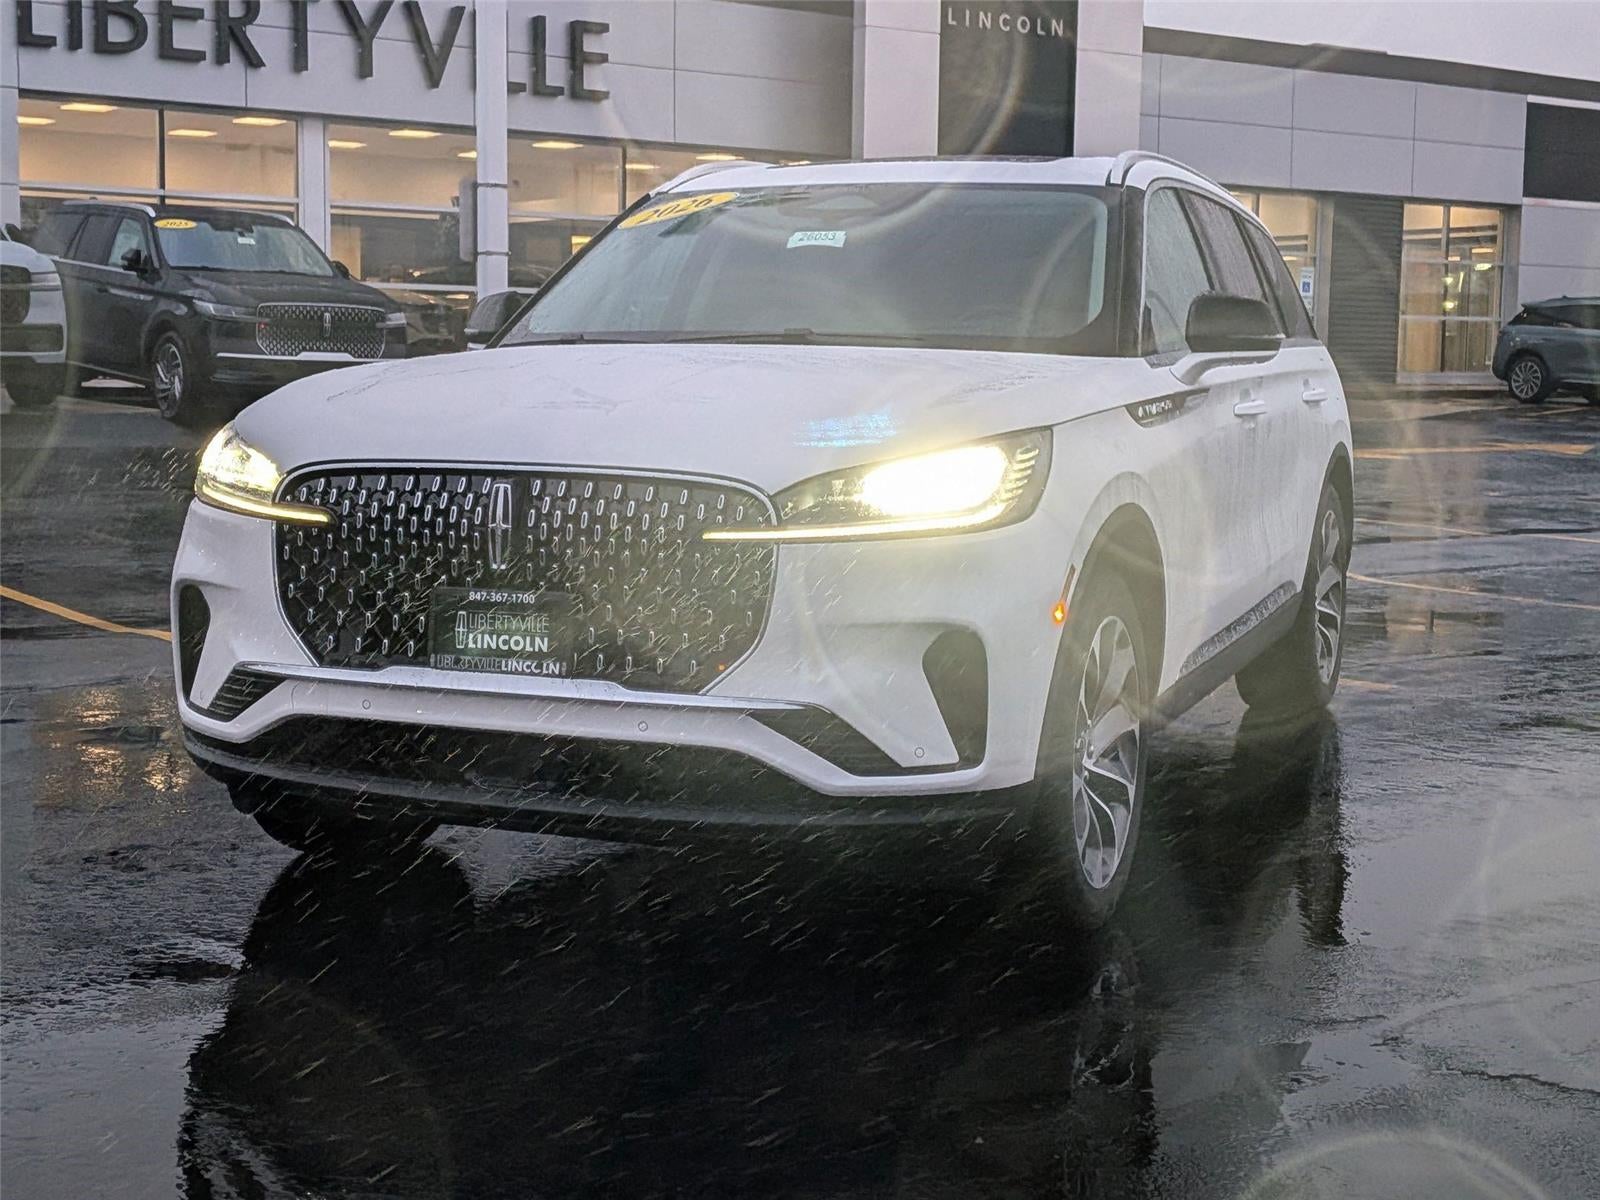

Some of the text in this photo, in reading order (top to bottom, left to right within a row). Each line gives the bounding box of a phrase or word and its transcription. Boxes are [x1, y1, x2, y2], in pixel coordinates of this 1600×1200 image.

[947, 7, 1064, 37] LINCOLN
[16, 0, 609, 101] LIBERTYVLE
[636, 197, 714, 224] 2026
[469, 591, 535, 604] 847-367-1700
[469, 613, 550, 633] LIBERTYVILLE
[467, 633, 549, 653] LINCOLN
